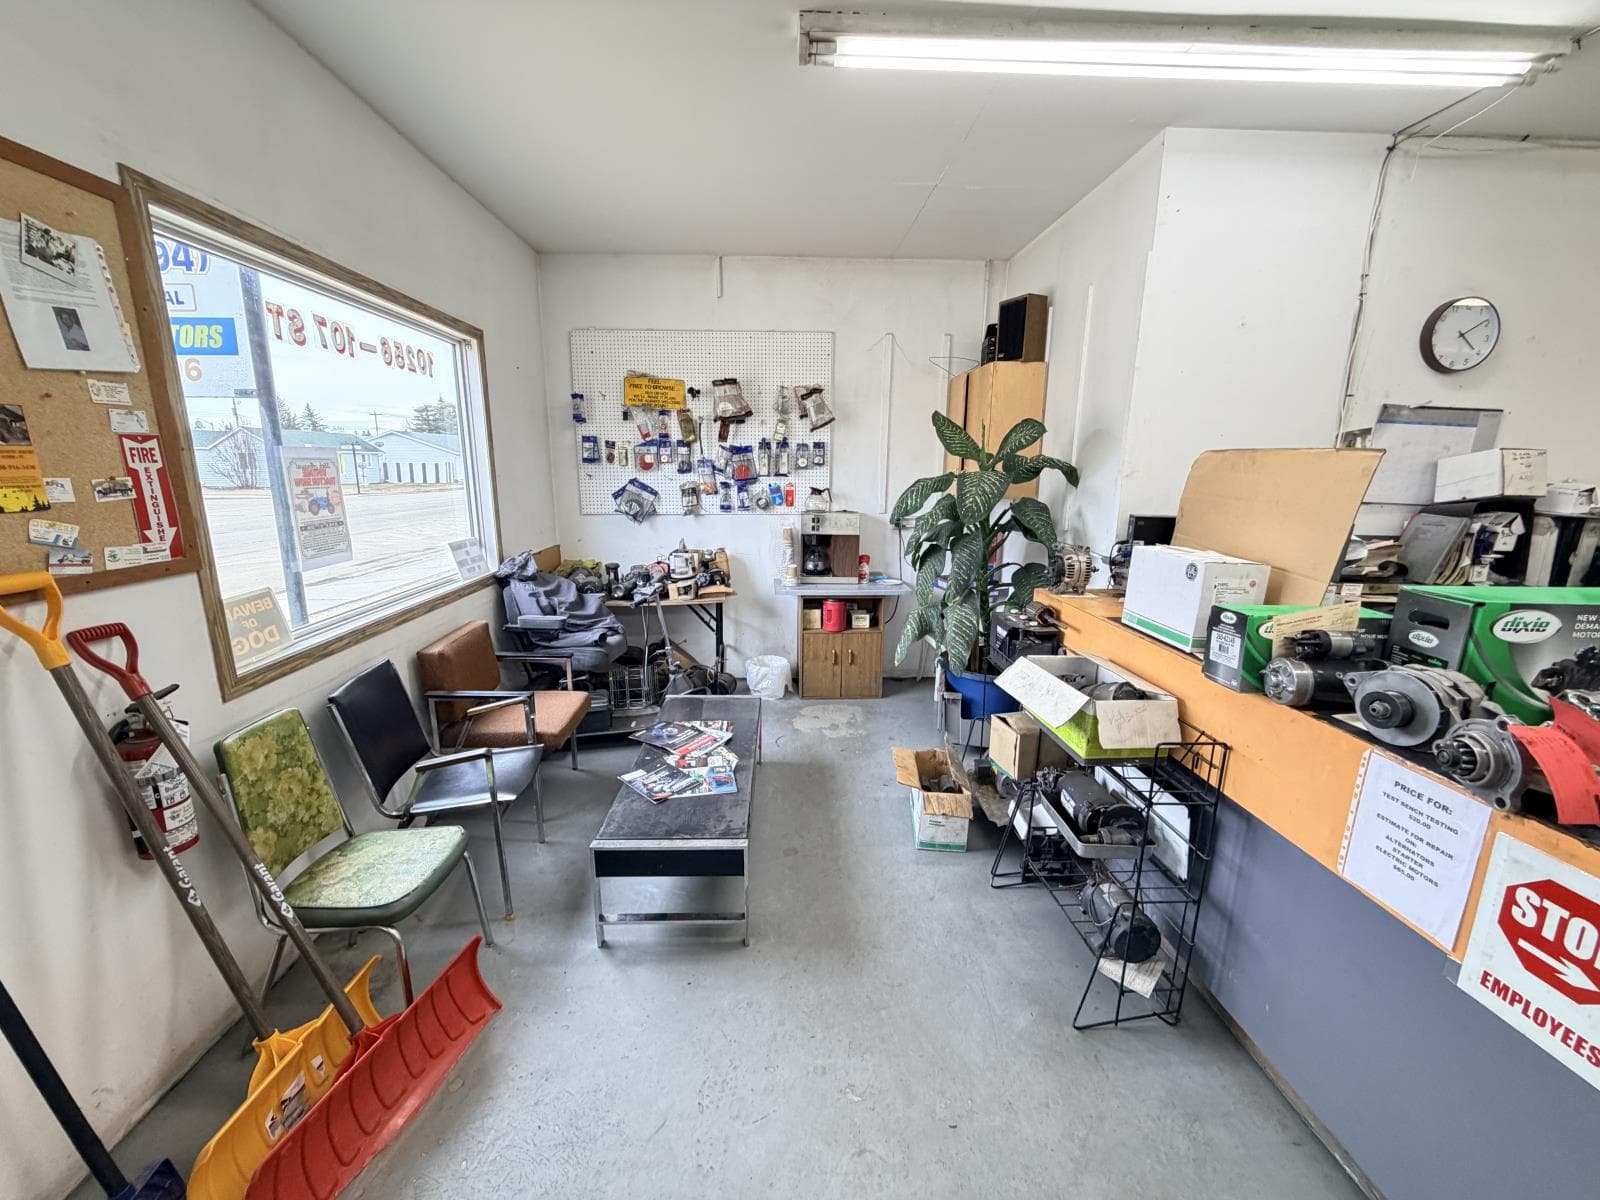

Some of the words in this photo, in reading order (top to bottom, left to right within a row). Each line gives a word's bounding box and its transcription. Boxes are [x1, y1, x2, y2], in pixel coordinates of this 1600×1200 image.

[129, 447, 158, 463] FIRE
[144, 467, 166, 542] EXTINGUISHE
[1383, 791, 1400, 803] TEST
[1400, 801, 1424, 817] BENCH
[1425, 814, 1459, 835] TESTING
[1394, 781, 1424, 801] PRICE
[1427, 797, 1453, 815] FOR:
[1376, 812, 1409, 834] ESTIMATE
[1410, 832, 1424, 843] FOR
[1425, 841, 1454, 860] REPAIR
[1385, 834, 1435, 867] ALTERNATORS
[163, 846, 192, 888] Garant
[1375, 845, 1407, 868] ELECTRIC
[1408, 865, 1439, 887] MOTORS
[1392, 847, 1424, 869] STARTER
[254, 863, 284, 901] Garant
[1511, 886, 1600, 970] STO
[1479, 970, 1600, 1068] EMPLOYEES
